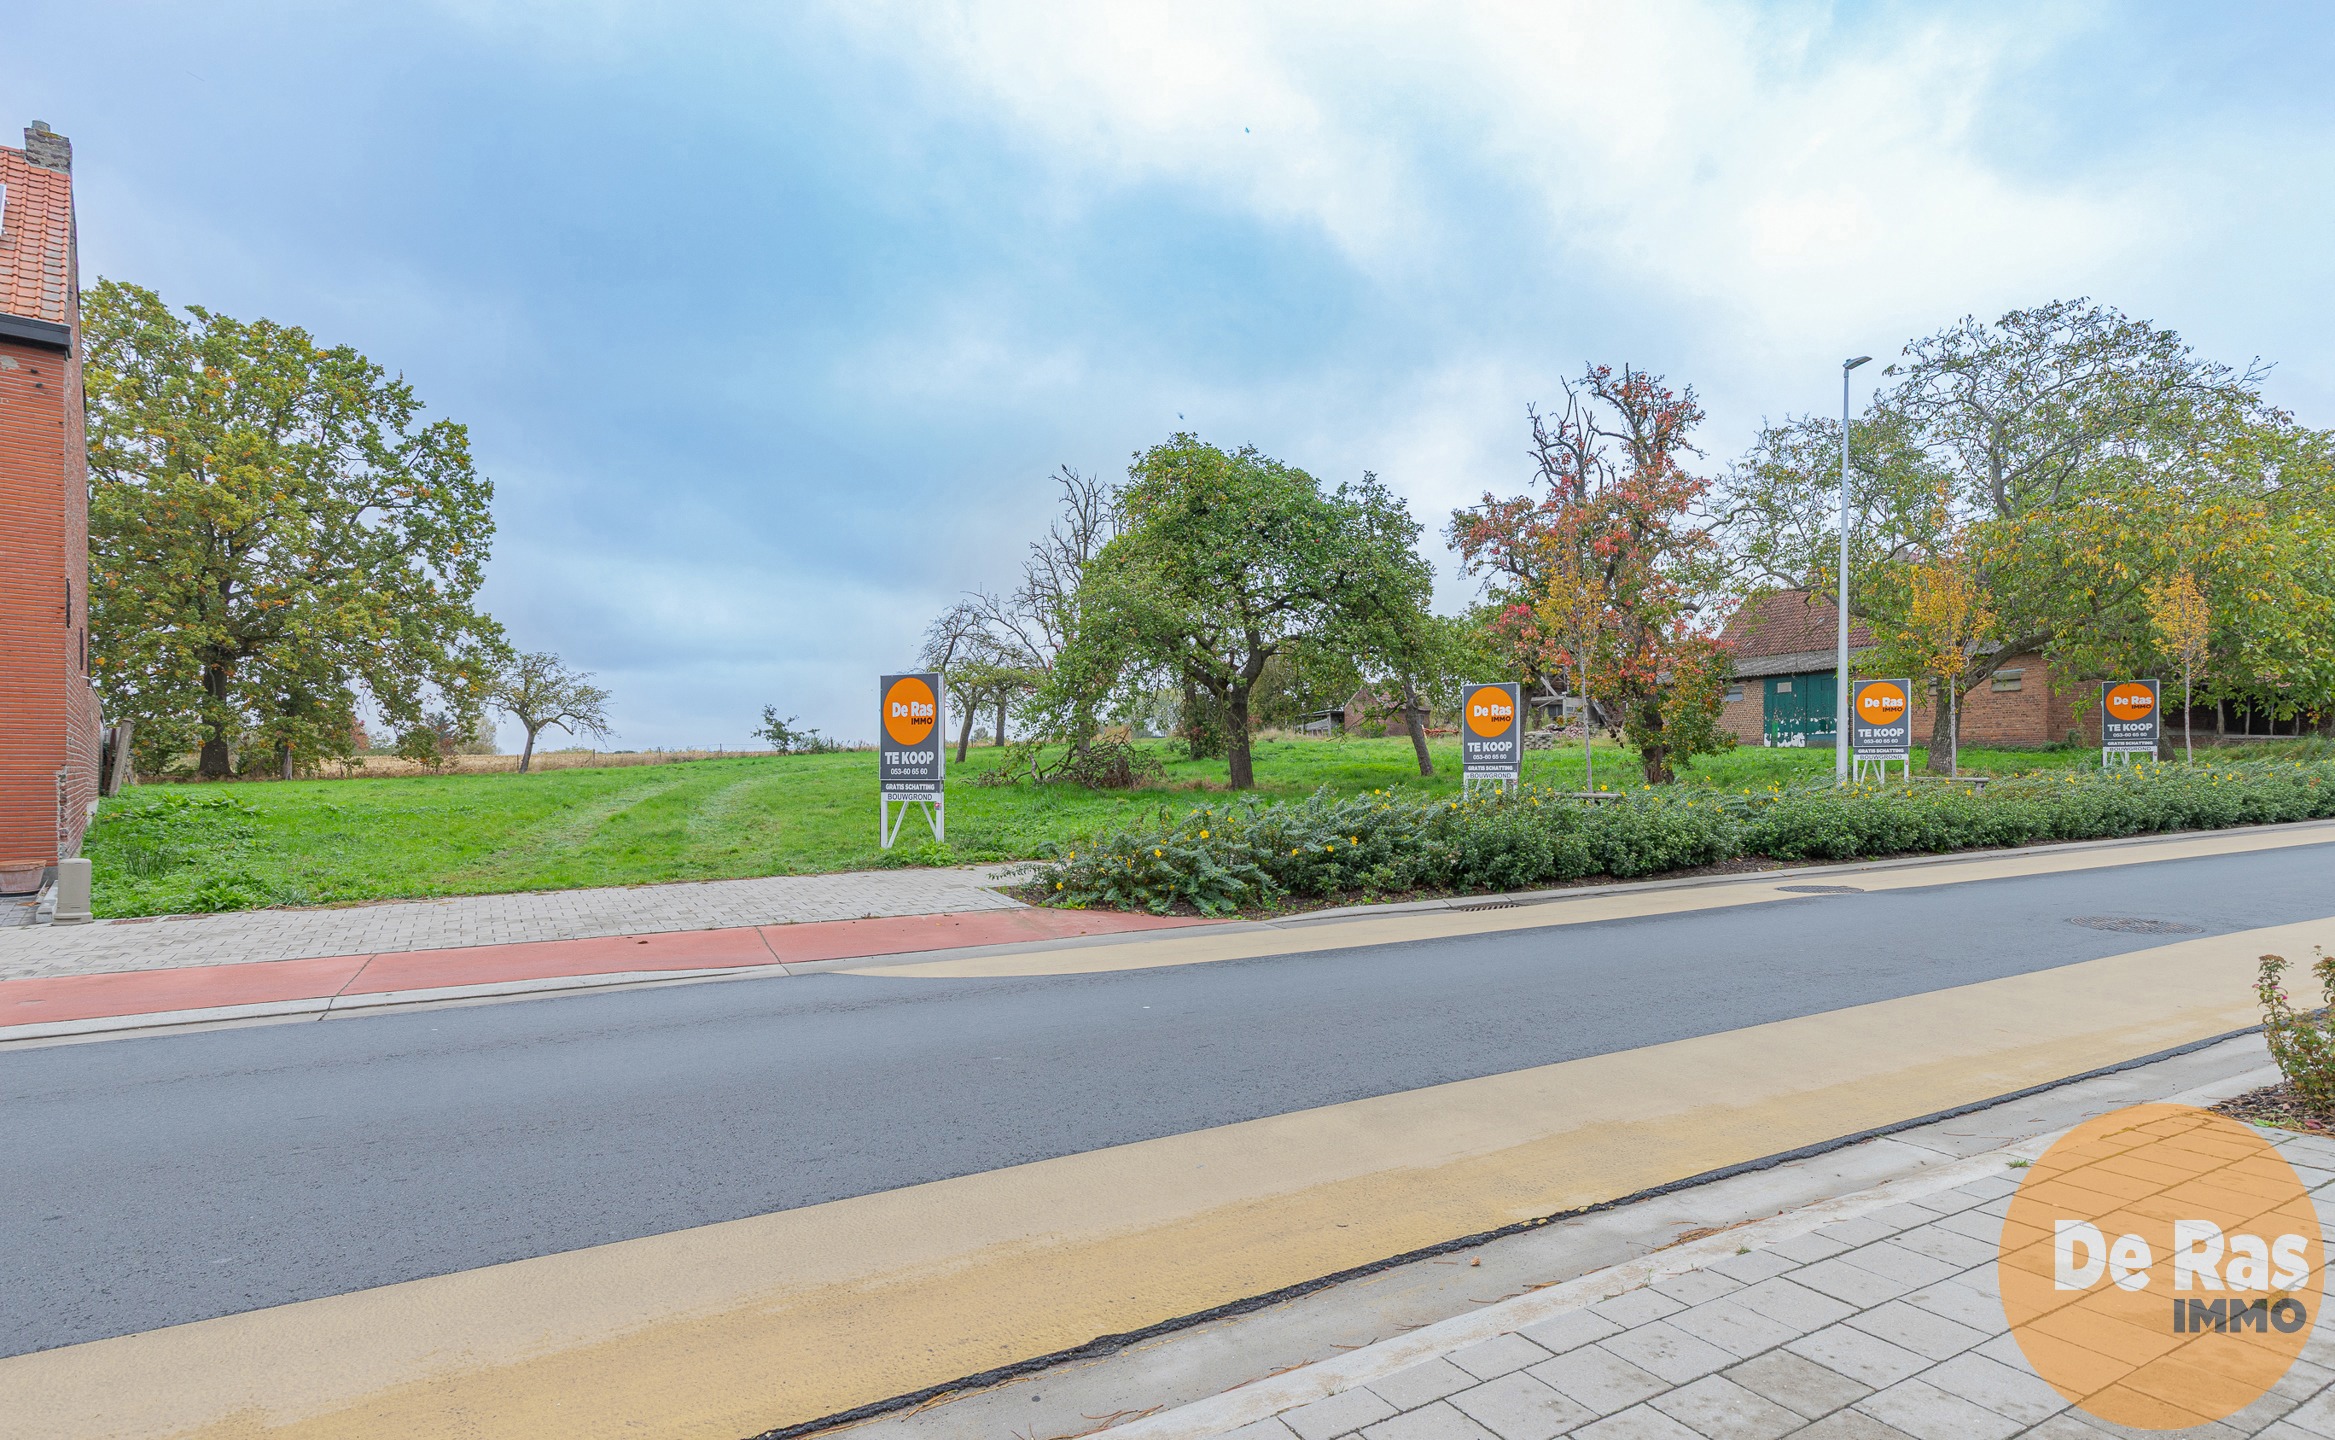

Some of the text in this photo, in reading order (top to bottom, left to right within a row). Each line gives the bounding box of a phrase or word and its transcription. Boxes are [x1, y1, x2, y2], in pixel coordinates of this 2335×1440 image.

[1864, 697, 1903, 708] De Ras
[2113, 695, 2152, 705] De Ras
[892, 701, 933, 717] De Ras
[1473, 704, 1512, 717] De Ras
[911, 717, 933, 725] IMMO
[1858, 728, 1904, 737] TE KOOP
[2107, 723, 2153, 731] TE KOOP
[1467, 741, 1512, 752] TE KOOP
[884, 751, 934, 764] TE KOOP
